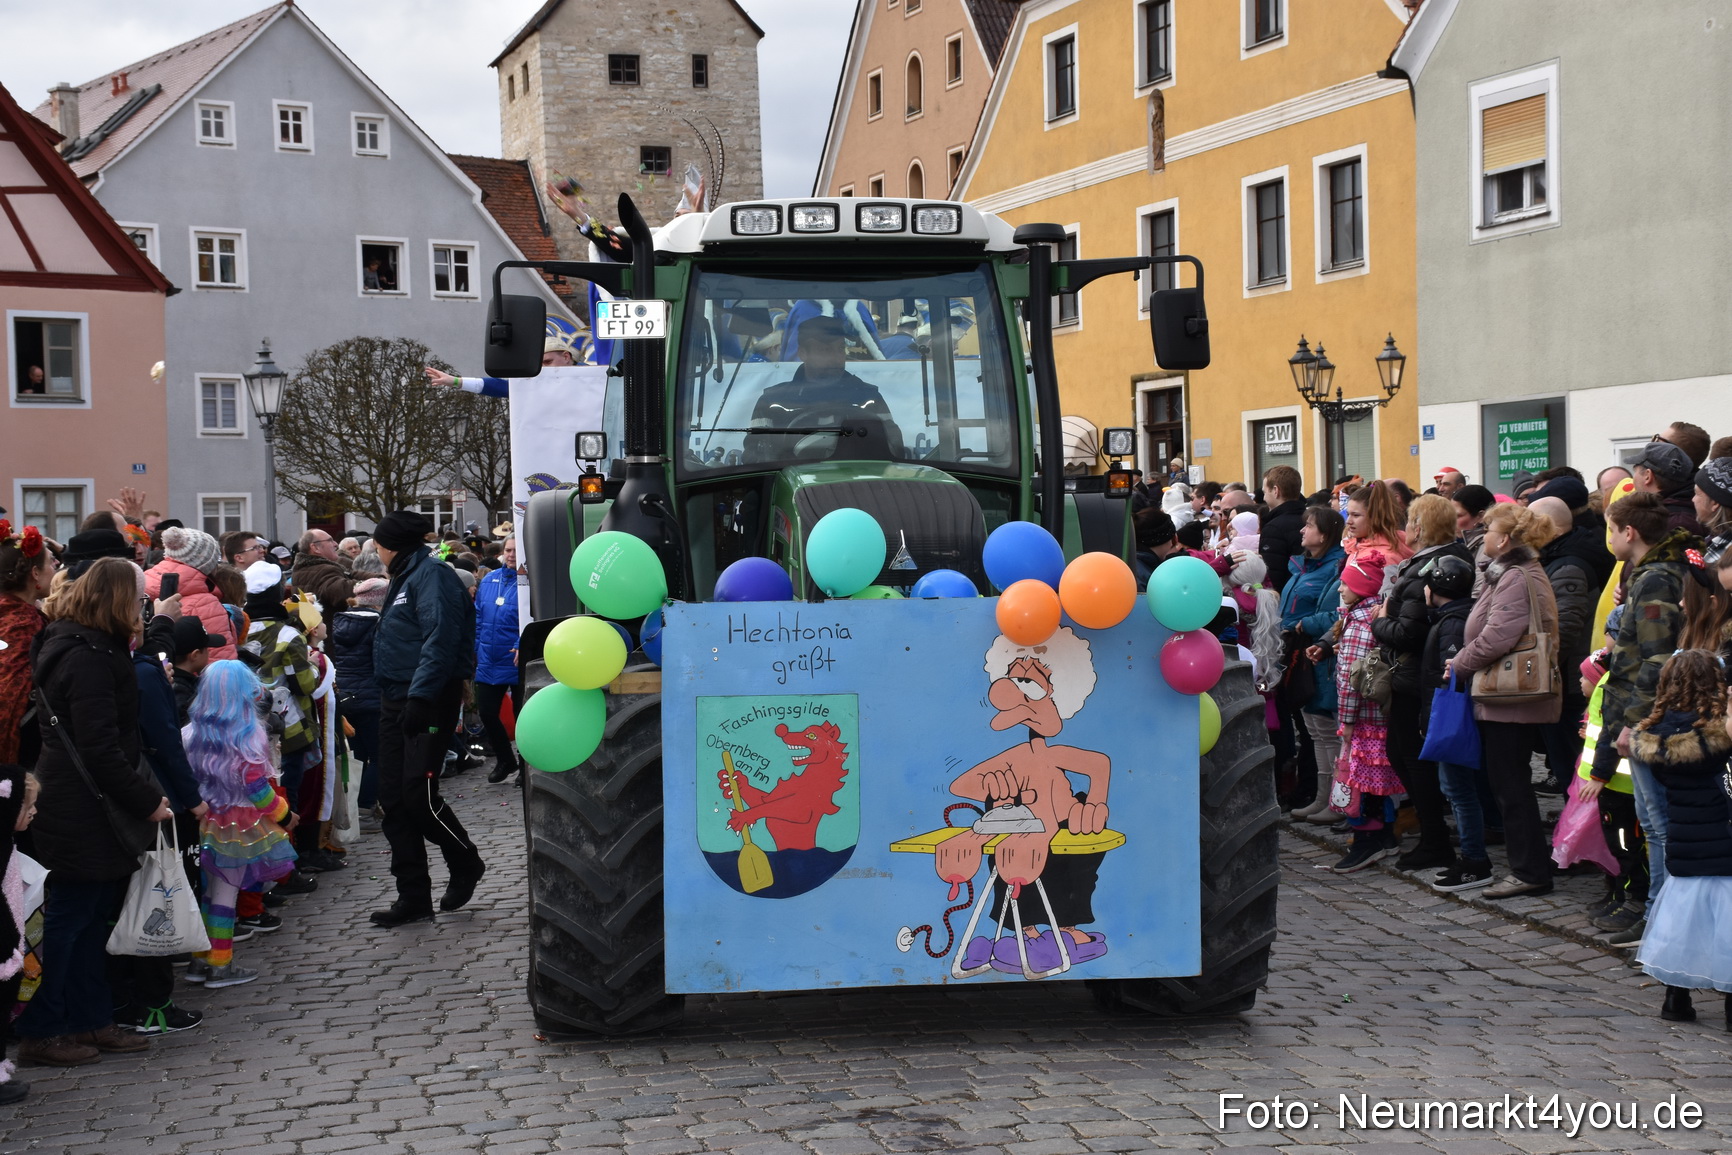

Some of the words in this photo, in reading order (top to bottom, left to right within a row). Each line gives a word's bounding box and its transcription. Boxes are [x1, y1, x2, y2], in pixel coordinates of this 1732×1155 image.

[612, 303, 631, 318] EI
[607, 320, 628, 335] FT
[635, 320, 654, 335] 99
[1266, 425, 1290, 442] BW
[1498, 424, 1508, 434] ZU
[1509, 421, 1547, 432] VERMIETEN
[1499, 459, 1519, 471] 09181
[1524, 457, 1548, 469] 465173
[728, 611, 852, 644] Hechtonia
[772, 646, 836, 685] grüßt
[718, 702, 830, 735] Faschingsgilde
[706, 734, 771, 771] Obernberg
[735, 760, 753, 774] am
[753, 767, 770, 785] Inn
